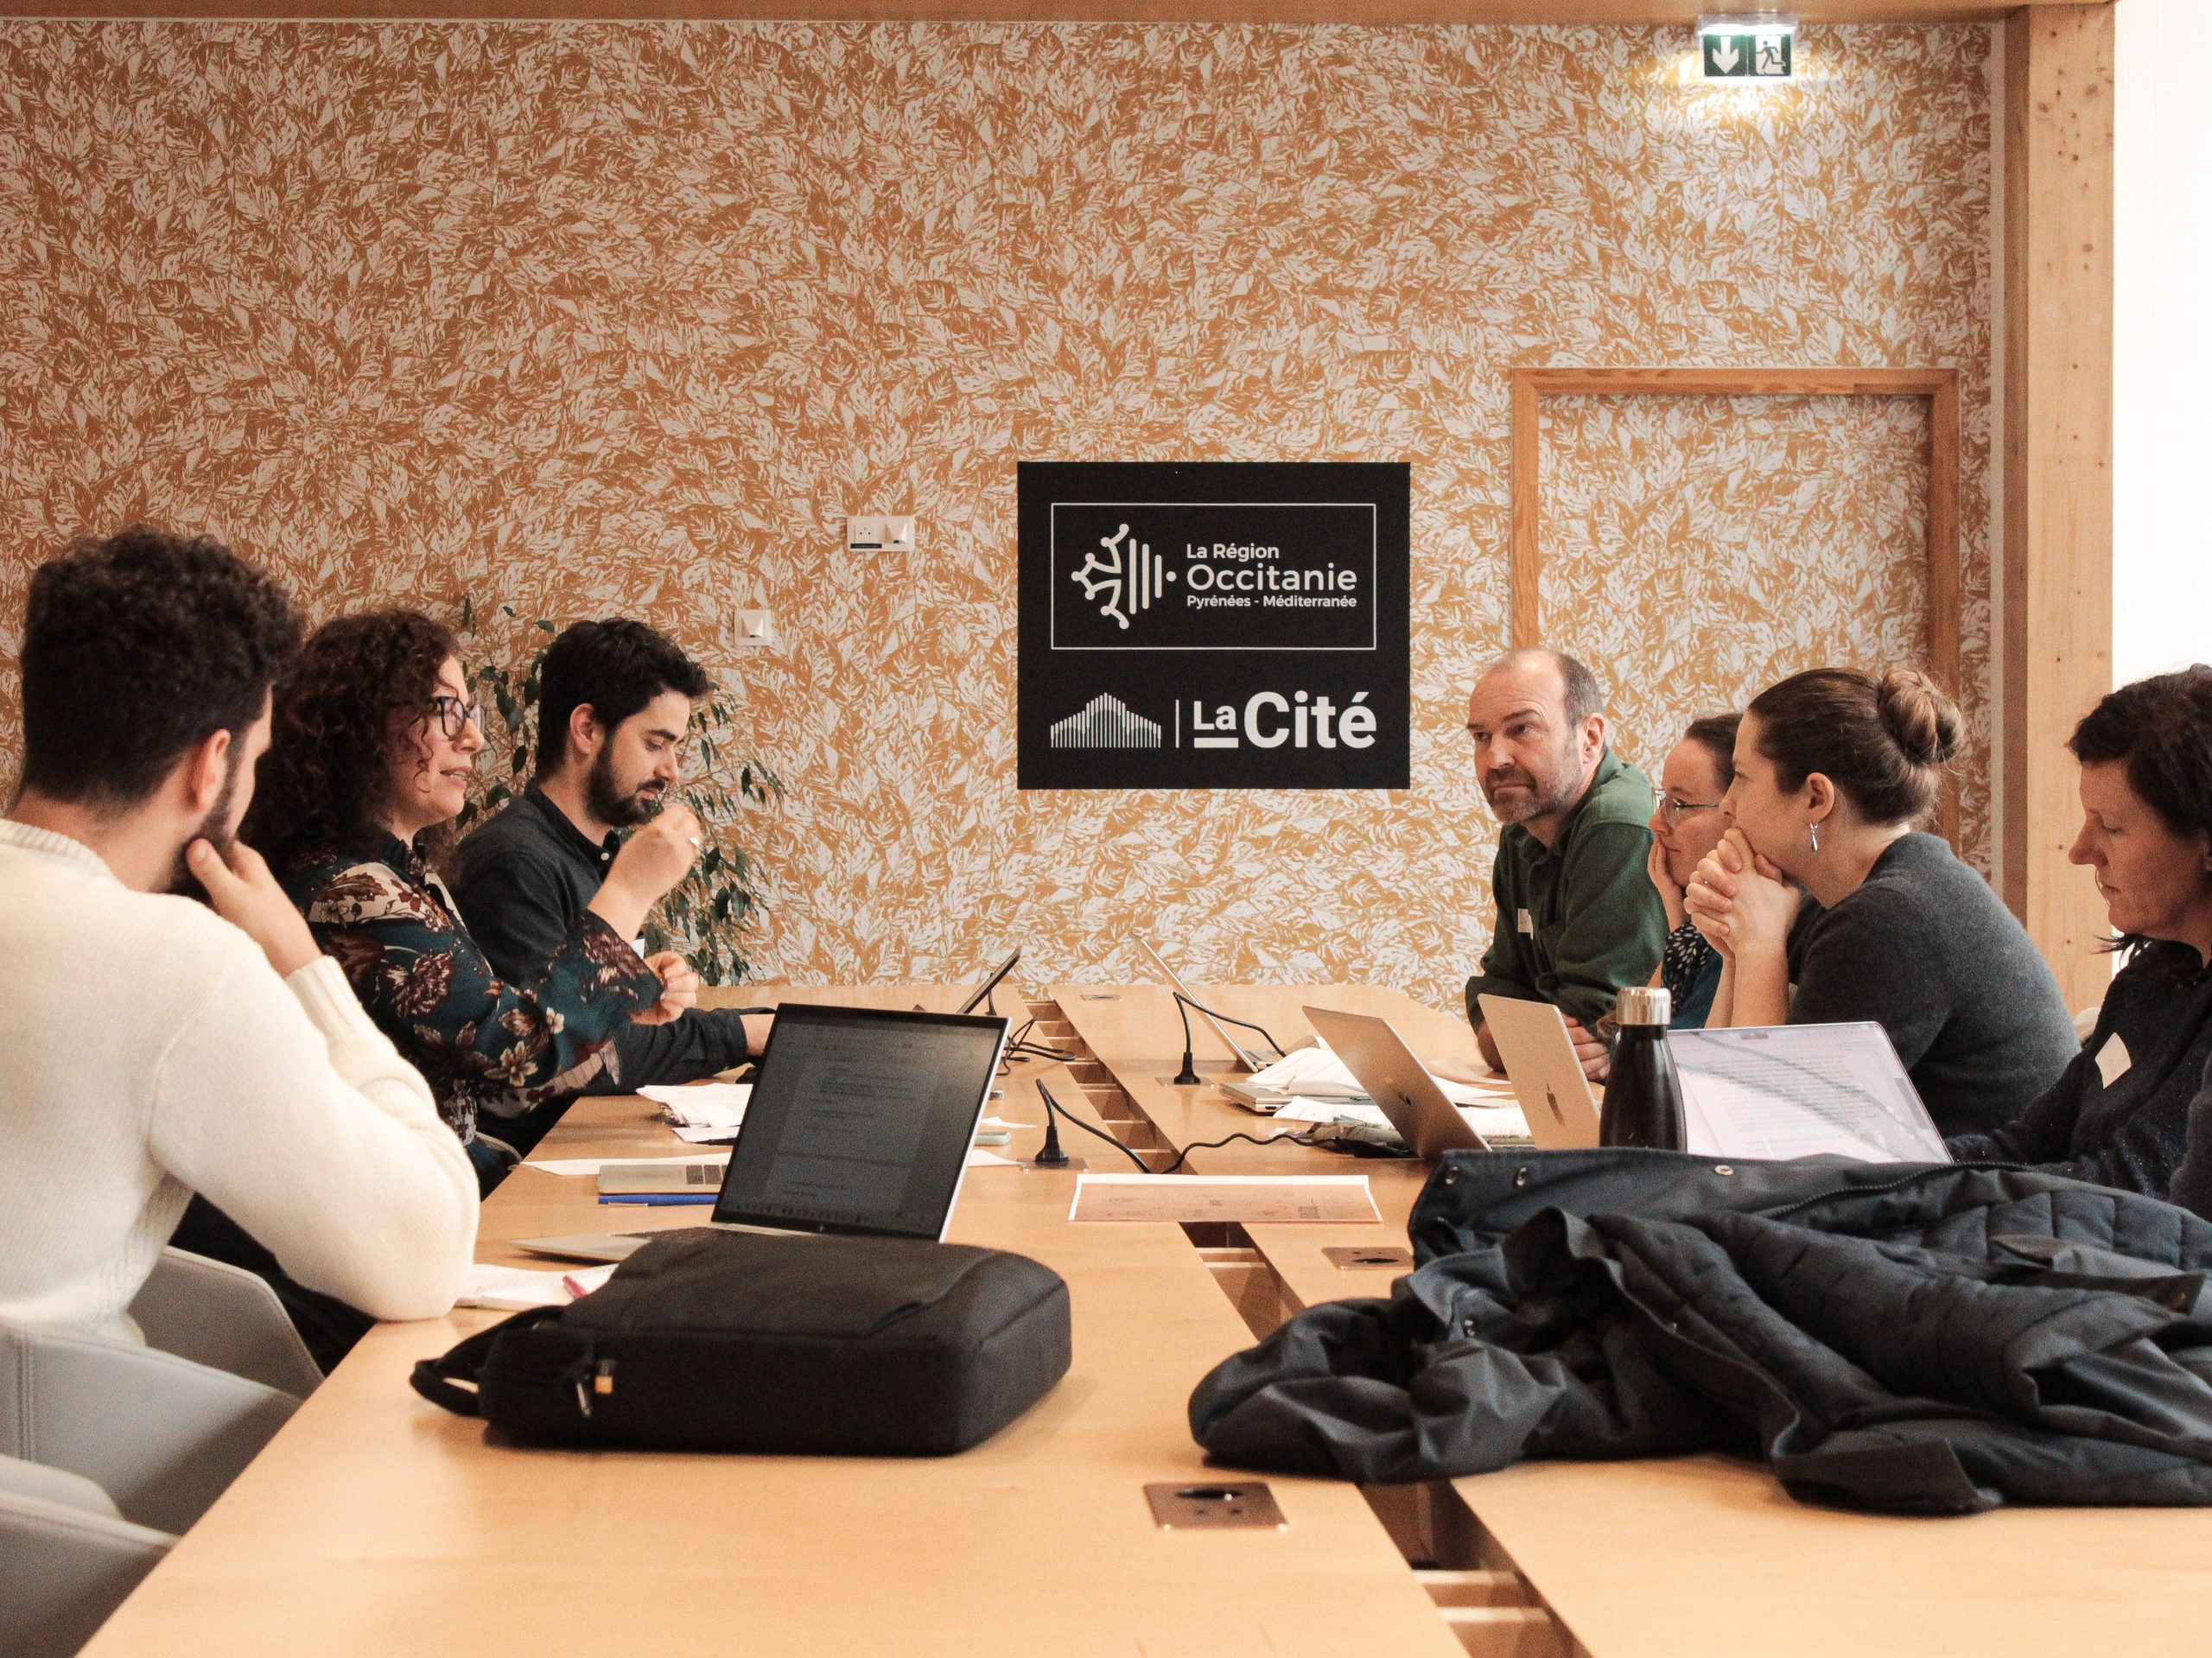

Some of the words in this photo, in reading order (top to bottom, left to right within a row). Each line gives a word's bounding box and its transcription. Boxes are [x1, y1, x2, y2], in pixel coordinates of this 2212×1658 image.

[1186, 543, 1208, 559] La
[1212, 543, 1280, 562] Région
[1186, 562, 1357, 591] Occitanie
[1186, 595, 1251, 610] Pyrénées
[1262, 595, 1357, 607] Méditerranée
